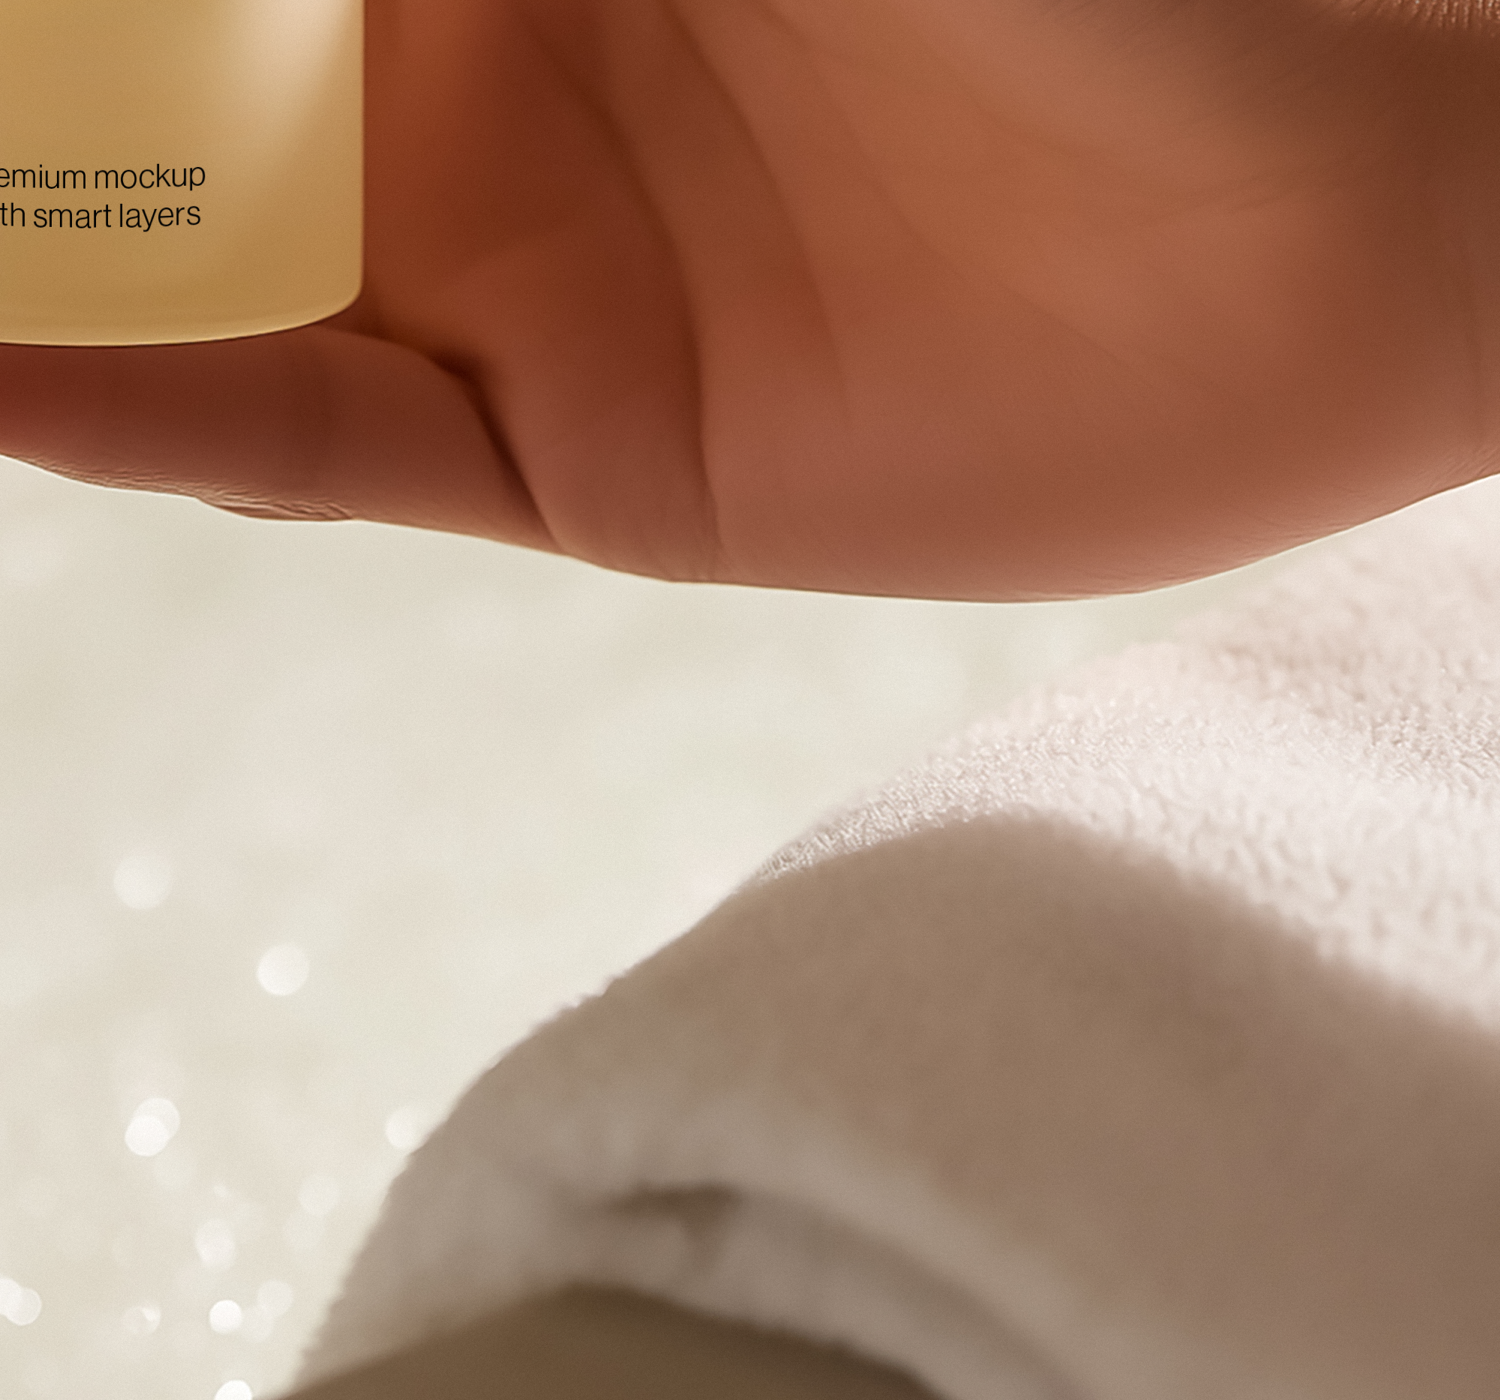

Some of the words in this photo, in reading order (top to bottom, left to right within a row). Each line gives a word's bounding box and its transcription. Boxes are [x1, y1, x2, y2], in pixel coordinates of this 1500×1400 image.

[94, 162, 206, 194] mockup
[33, 203, 113, 230] smart
[119, 201, 202, 233] layers
